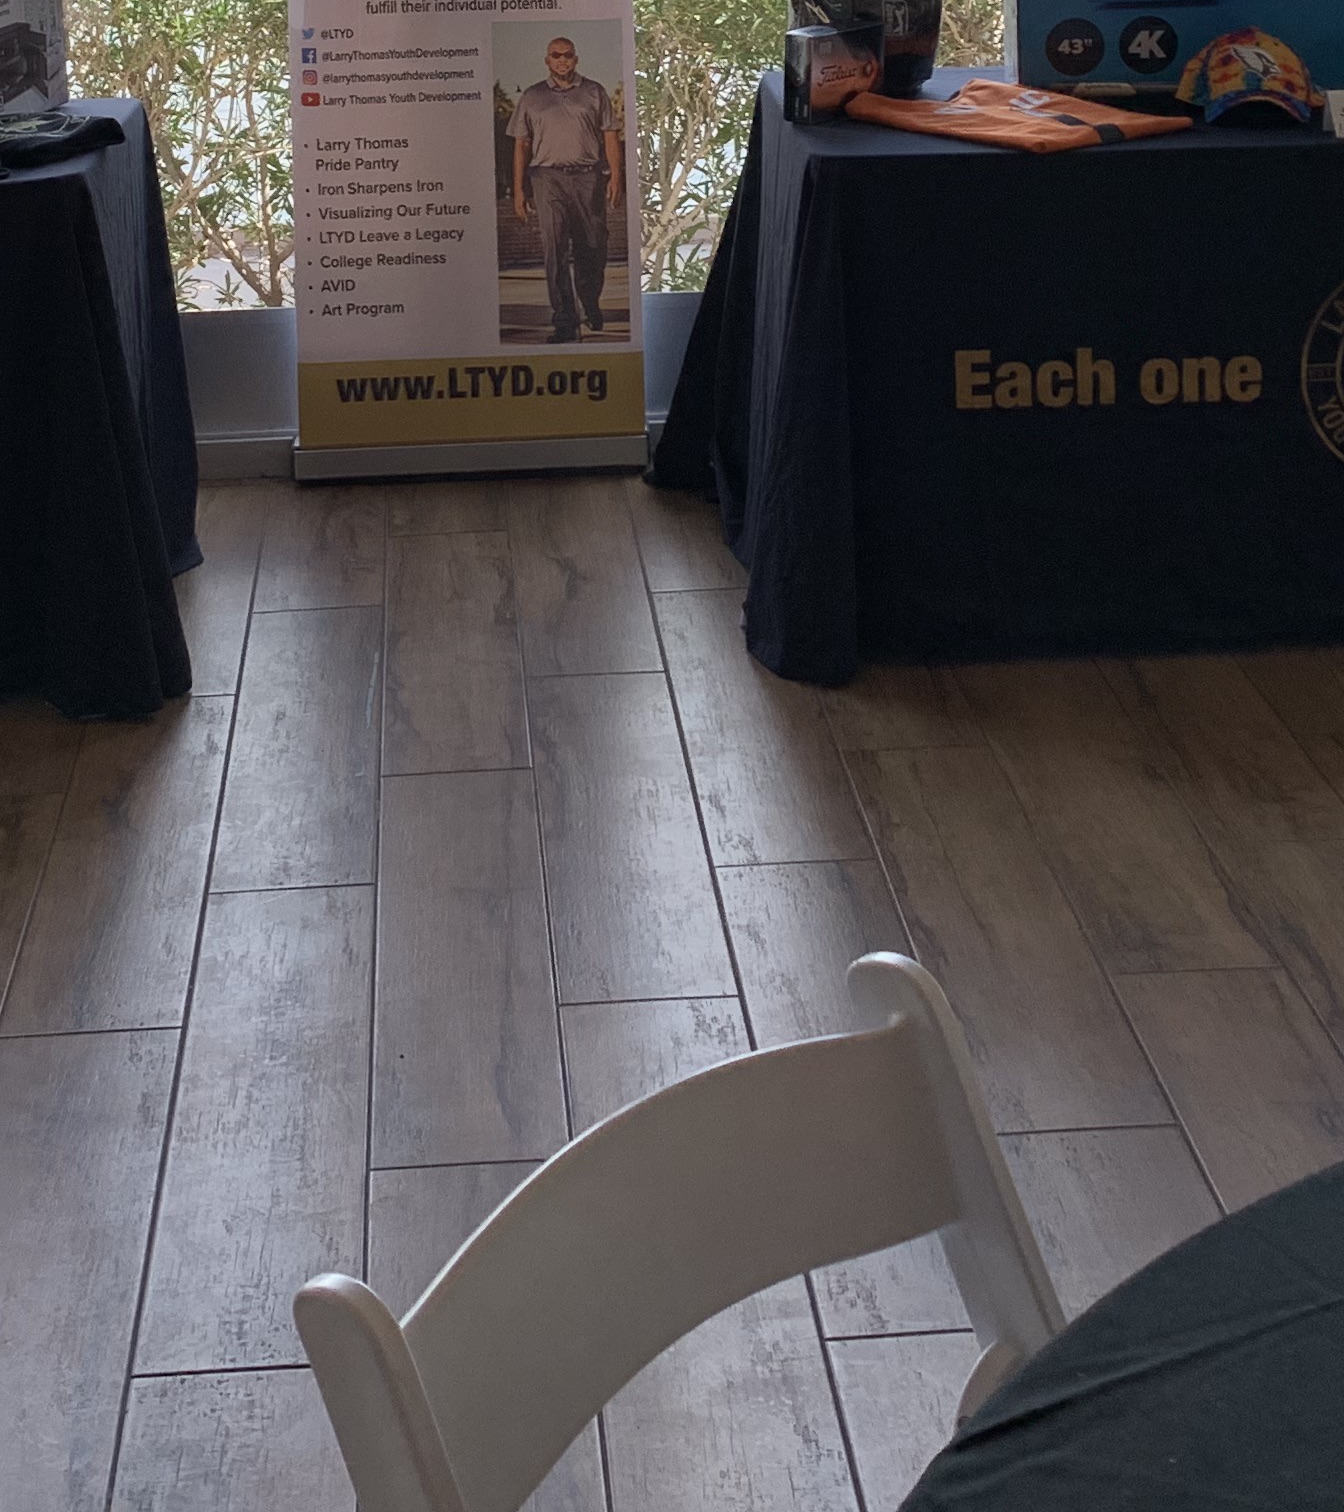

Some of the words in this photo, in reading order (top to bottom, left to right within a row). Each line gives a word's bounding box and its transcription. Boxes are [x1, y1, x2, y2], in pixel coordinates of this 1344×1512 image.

[366, 0, 398, 14] fulfill
[400, 0, 431, 13] their
[320, 28, 354, 39] @LTYD
[1127, 29, 1167, 59] 4K
[321, 47, 479, 63] @LarryThomasYouthDevelopment
[322, 69, 475, 84] @larrythomasyouthdevelopment
[323, 95, 346, 108] Larry
[349, 94, 387, 105] Thomas
[389, 92, 416, 103] Youth
[418, 91, 482, 103] Development
[316, 139, 350, 153] Larry
[354, 137, 409, 150] Thomas
[315, 159, 351, 171] Pride
[355, 157, 399, 172] Pantry
[317, 183, 345, 196] Iron
[347, 181, 413, 196] Sharpens
[417, 179, 444, 192] Iron
[318, 205, 393, 220] Visualizing
[396, 204, 421, 216] Our
[425, 202, 471, 216] Future
[319, 231, 355, 244] LTYD
[359, 230, 400, 243] Leave
[403, 231, 411, 241] a
[415, 227, 464, 242] Legacy
[320, 255, 372, 270] College
[376, 252, 446, 266] Readiness
[320, 279, 356, 293] AVID
[321, 304, 343, 316] Art
[346, 302, 404, 317] Program
[336, 364, 609, 403] www.LTYD.org
[953, 346, 1117, 410] Each
[1139, 354, 1264, 404] one
